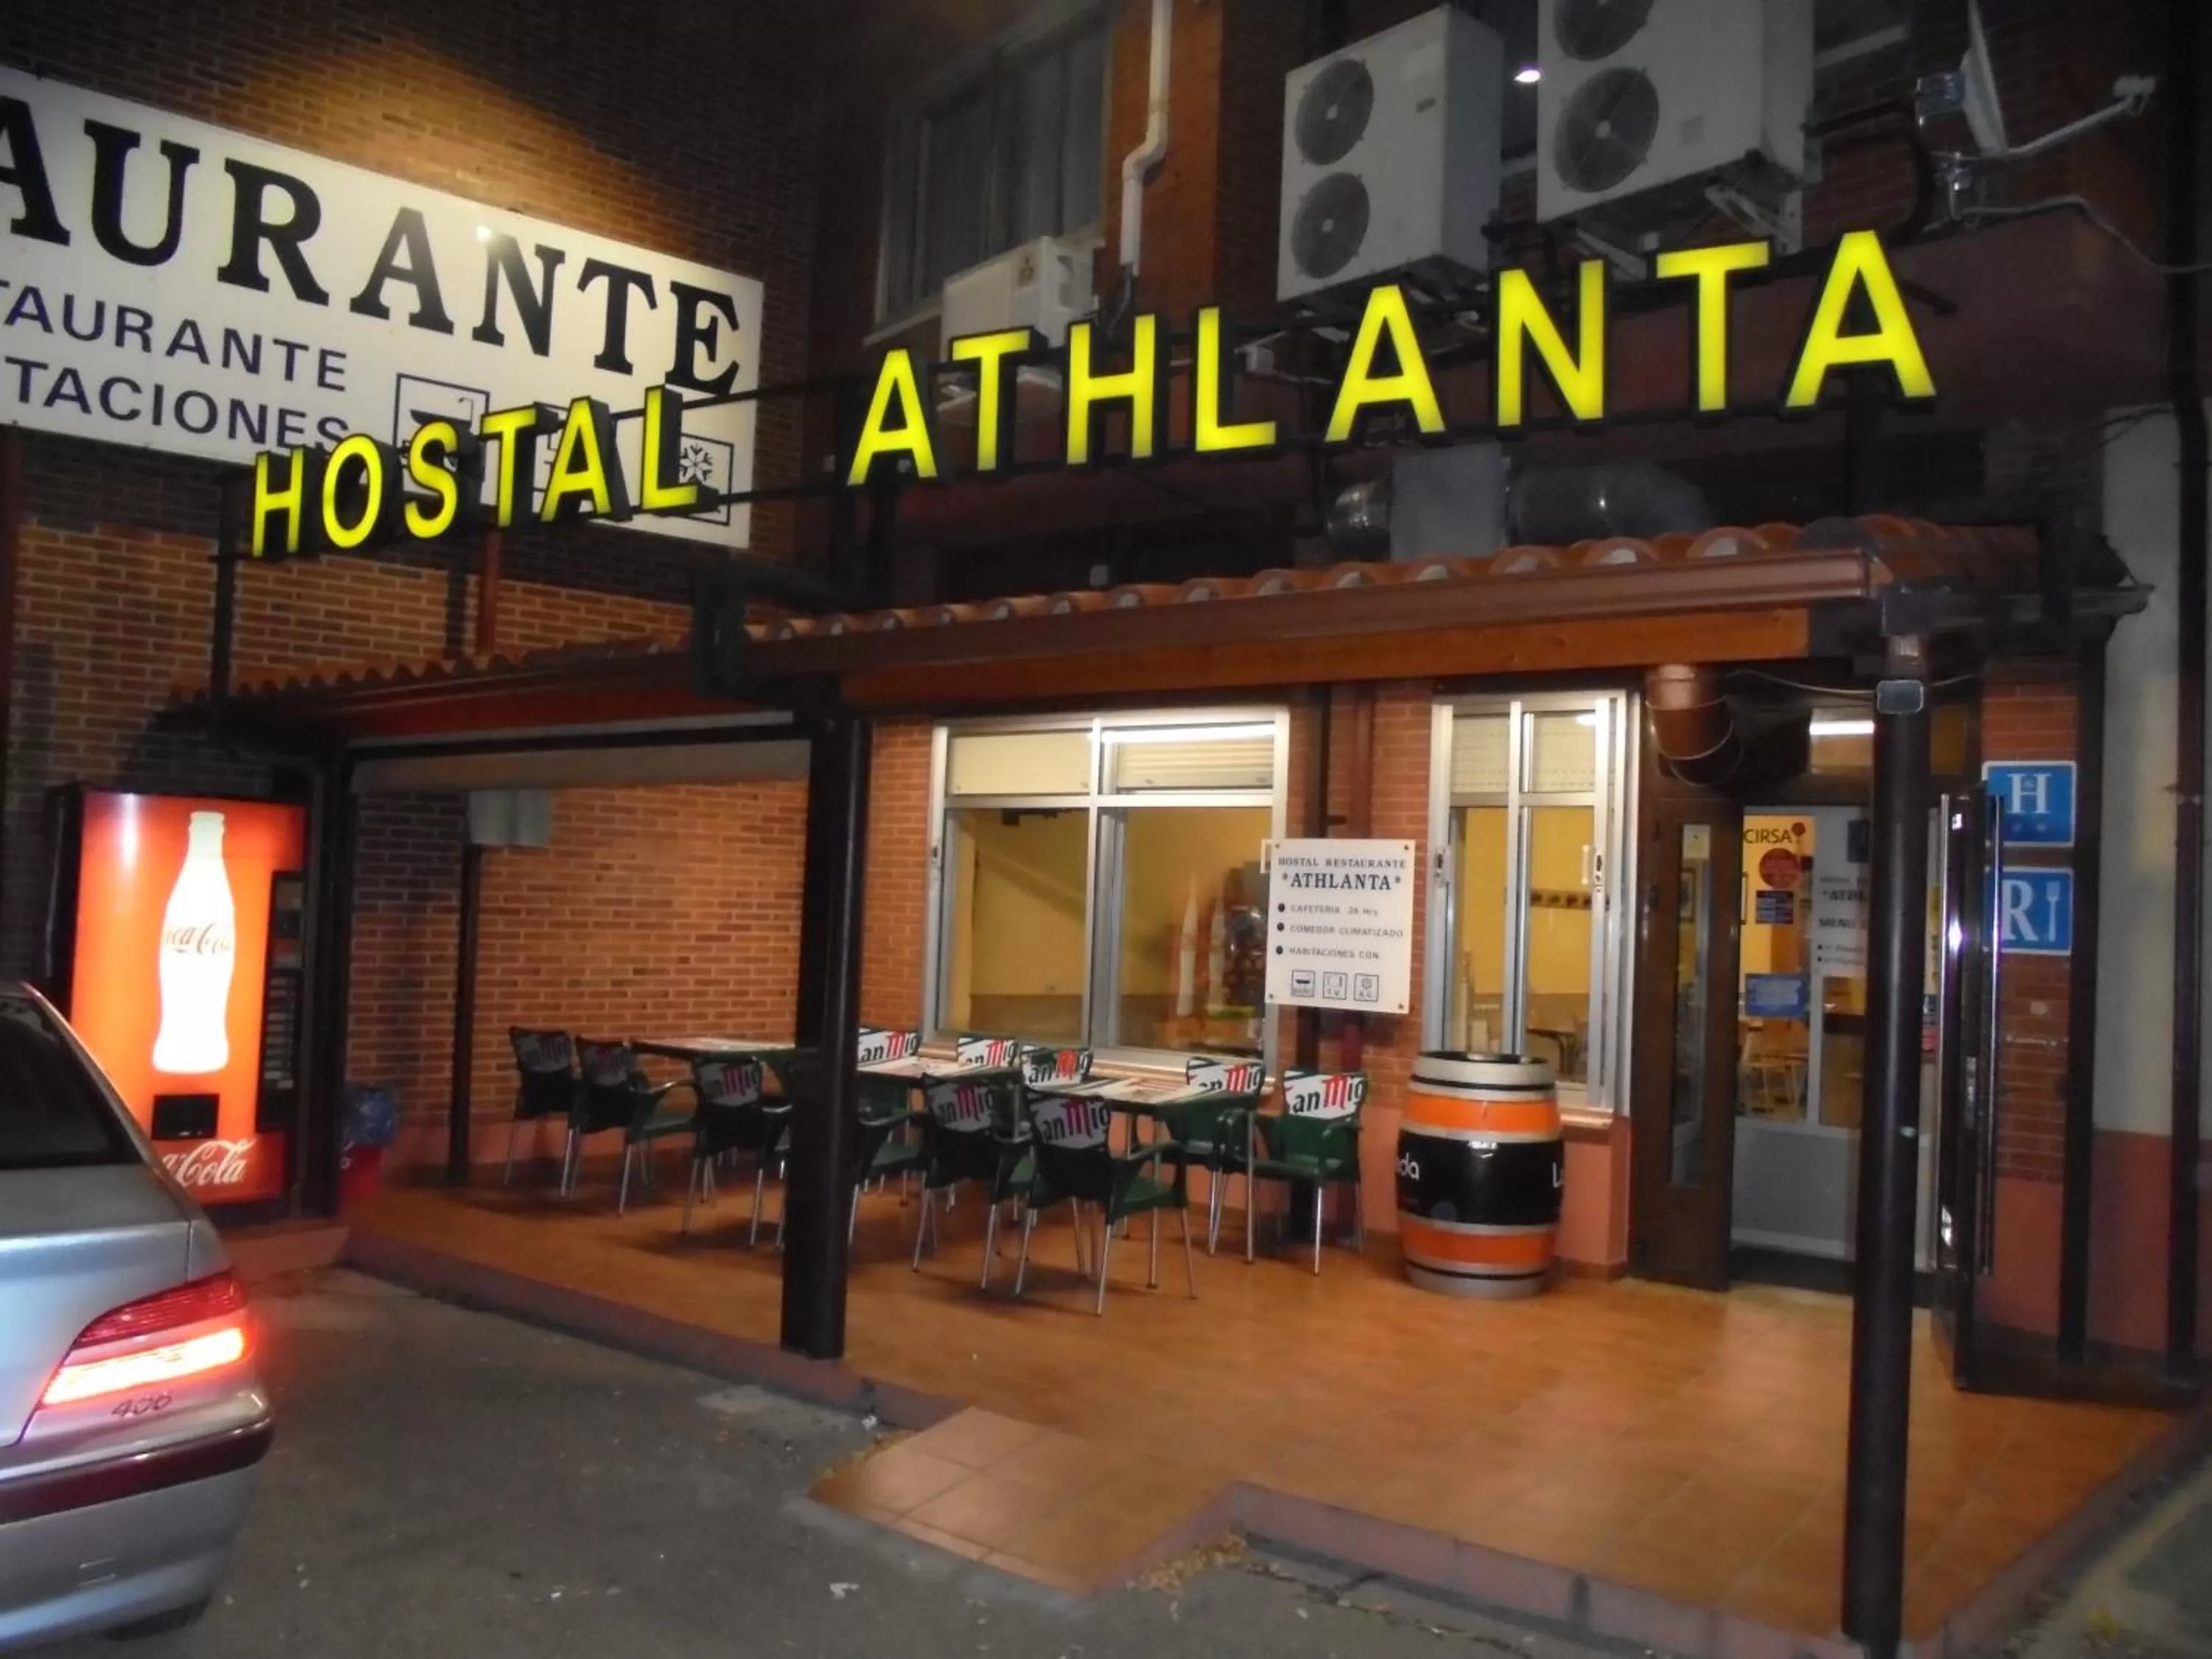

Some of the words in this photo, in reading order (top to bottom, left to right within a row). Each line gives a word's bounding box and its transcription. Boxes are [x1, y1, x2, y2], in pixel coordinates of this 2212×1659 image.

[0, 279, 347, 392] AURANTE
[845, 229, 1937, 487] ATHLANTA
[4, 355, 349, 452] TACIONES
[251, 384, 700, 558] HOSTAL
[2006, 773, 2053, 815] H
[1743, 828, 1792, 844] CIRSA
[1278, 857, 1320, 867] HOSTAL
[1325, 858, 1407, 869] RESTAURANTE
[1338, 926, 1404, 939] CLIMATIZADO
[2000, 879, 2039, 942] R
[1289, 947, 1355, 959] HABITACIONES
